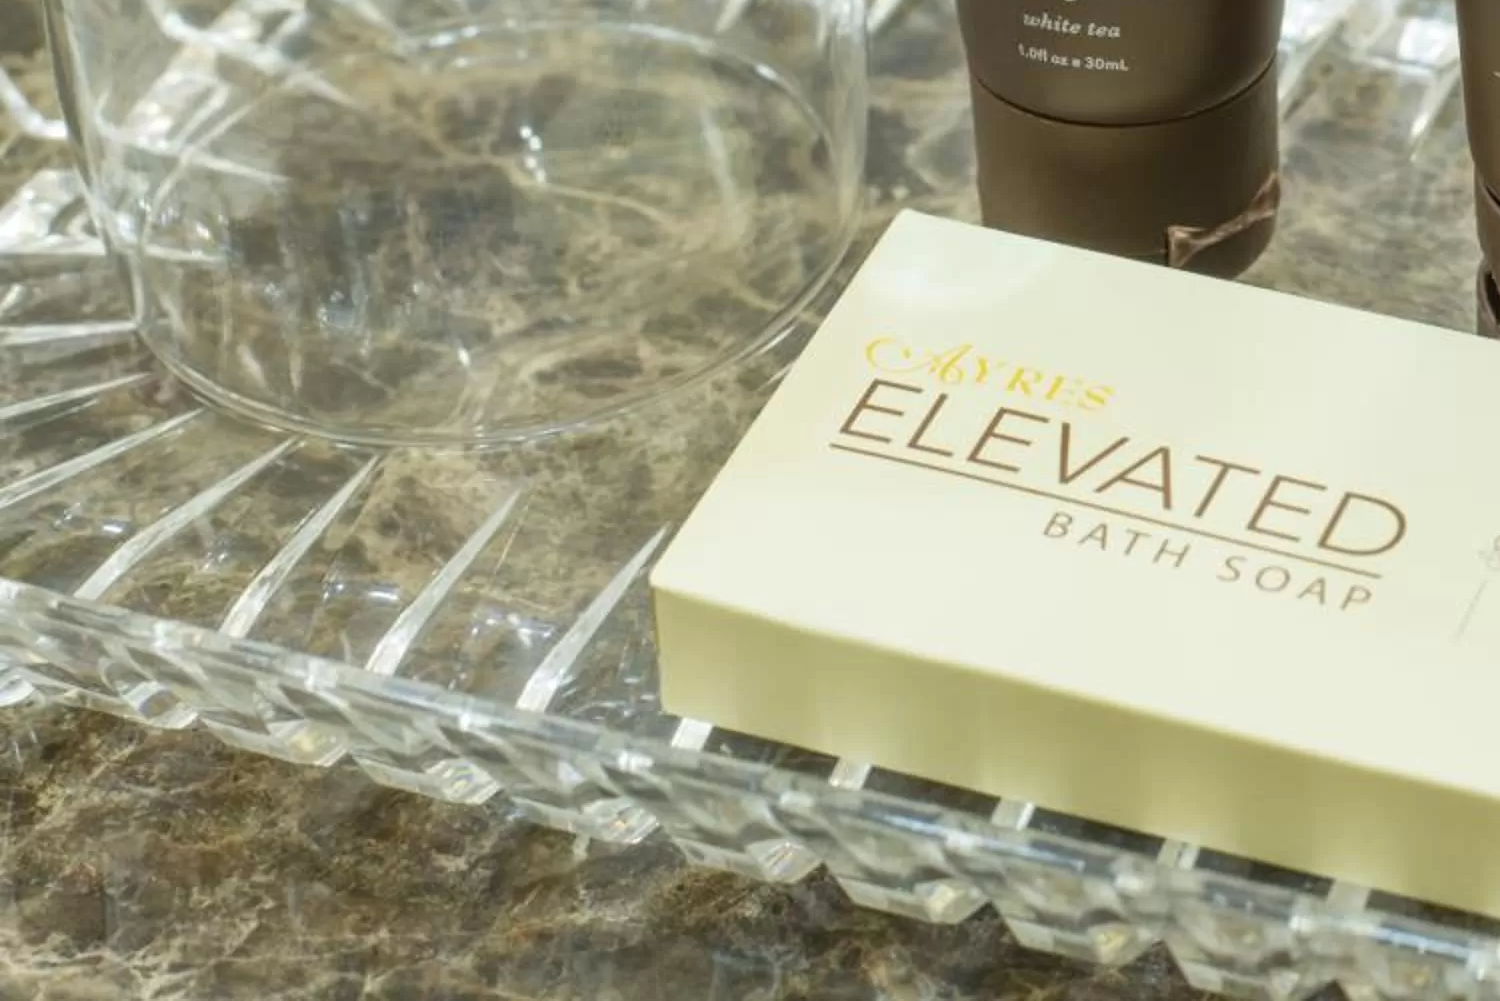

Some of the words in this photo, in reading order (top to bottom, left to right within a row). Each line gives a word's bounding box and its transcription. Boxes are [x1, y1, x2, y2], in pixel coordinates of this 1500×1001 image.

[1023, 12, 1082, 35] white
[1087, 22, 1121, 38] tea
[1051, 53, 1068, 66] oz
[1084, 56, 1129, 72] 30mL
[865, 335, 1116, 412] AYRES
[839, 378, 1407, 558] ELEVATED
[1043, 511, 1191, 569] BATH
[1216, 555, 1374, 612] SOAP
